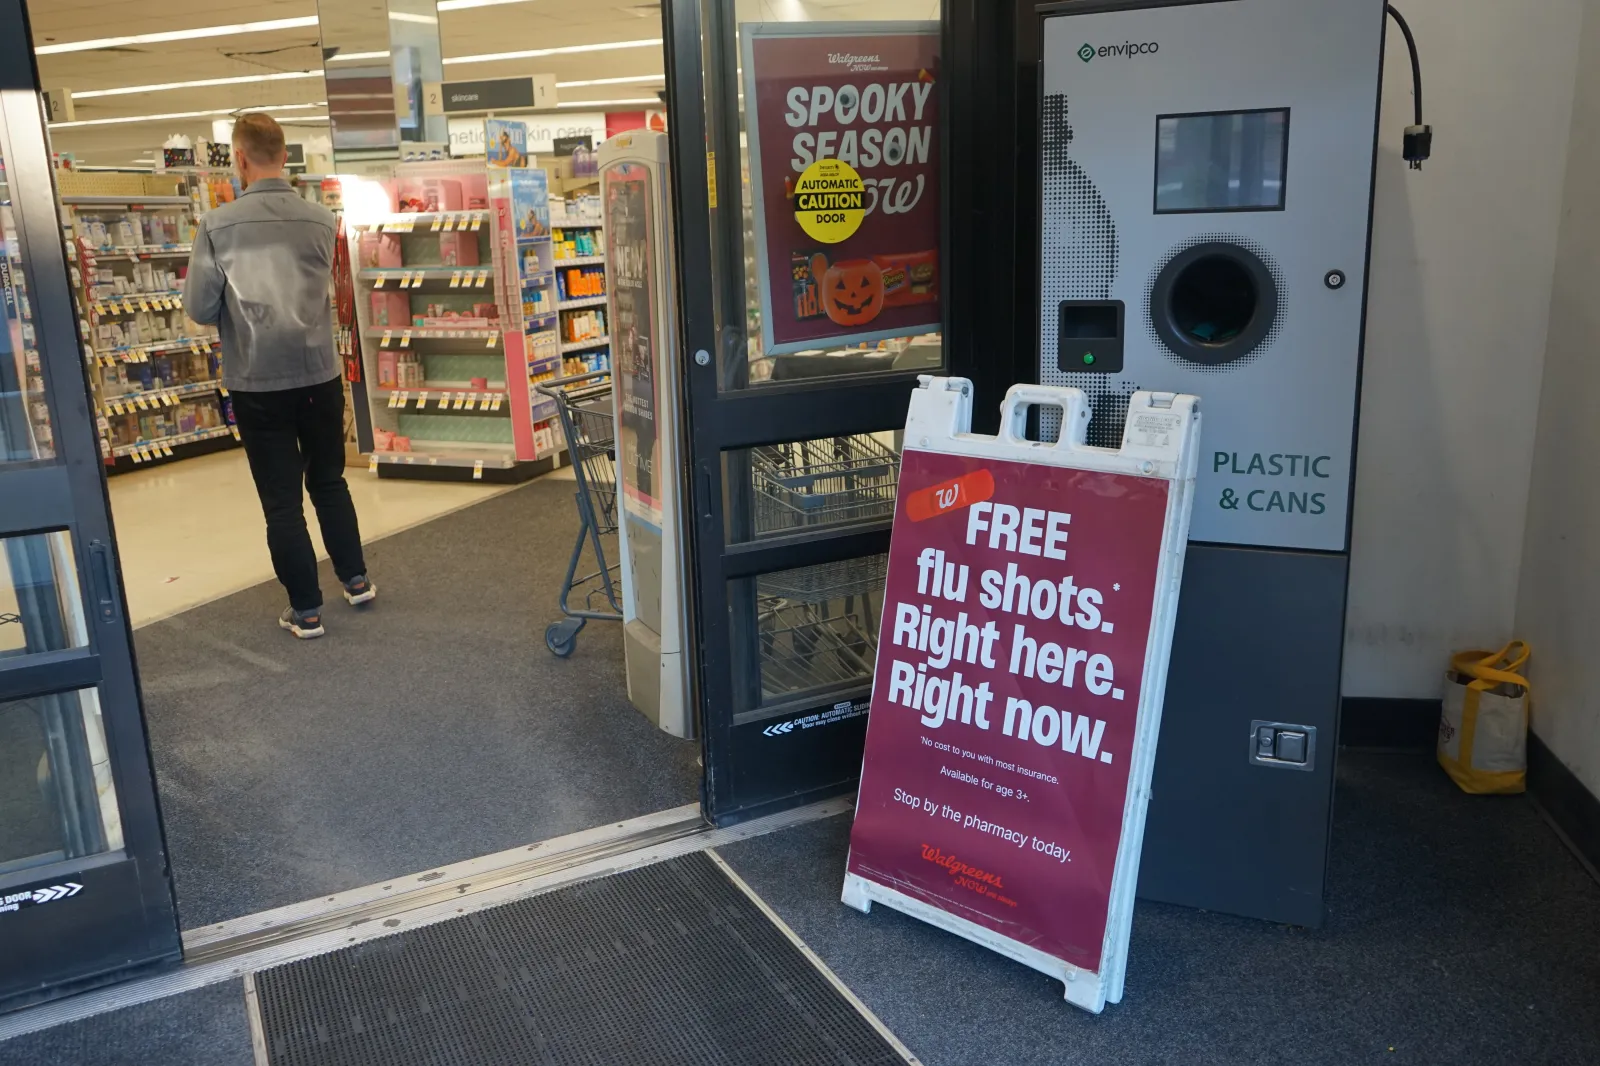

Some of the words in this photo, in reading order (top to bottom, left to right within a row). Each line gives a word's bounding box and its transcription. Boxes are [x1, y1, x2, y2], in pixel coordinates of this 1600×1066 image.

[827, 53, 880, 67] Walgreens
[1097, 40, 1159, 59] envipco
[430, 94, 436, 104] 2
[540, 86, 545, 97] 1
[785, 82, 932, 127] SPOOKY
[52, 100, 58, 112] 2
[791, 126, 932, 173] SEASON
[801, 179, 859, 190] AUTOMATIC
[798, 193, 862, 210] CAUTION
[816, 213, 846, 224] DOOR
[1, 263, 13, 305] DURACELL
[1213, 451, 1331, 478] PLASTIC
[1219, 488, 1239, 510] &
[1247, 489, 1326, 515] CANS
[966, 501, 1071, 561] FREE
[917, 548, 969, 602] flu
[892, 602, 1000, 669] Right
[1009, 624, 1125, 701] here.
[794, 714, 820, 725] CAUTION:
[822, 706, 852, 719] AUTOMATIC
[854, 703, 871, 711] SLIDIN
[887, 659, 994, 730] Right
[1002, 696, 1114, 765] now.
[934, 741, 951, 752] cost
[952, 745, 961, 755] to
[962, 749, 976, 760] you
[977, 753, 994, 765] with
[995, 759, 1015, 772] most
[1016, 764, 1059, 785] insurance.
[940, 765, 979, 785] Available
[981, 777, 994, 790] for
[995, 784, 1014, 797] age
[1016, 789, 1030, 802] 3+.
[894, 787, 921, 809] Stop
[923, 796, 939, 816] by
[941, 803, 962, 822] the
[963, 814, 1029, 848] pharmacy
[1031, 836, 1072, 863] today.
[921, 843, 1004, 889] Walgreens
[5, 891, 31, 903] DOOR
[954, 876, 988, 894] NOW
